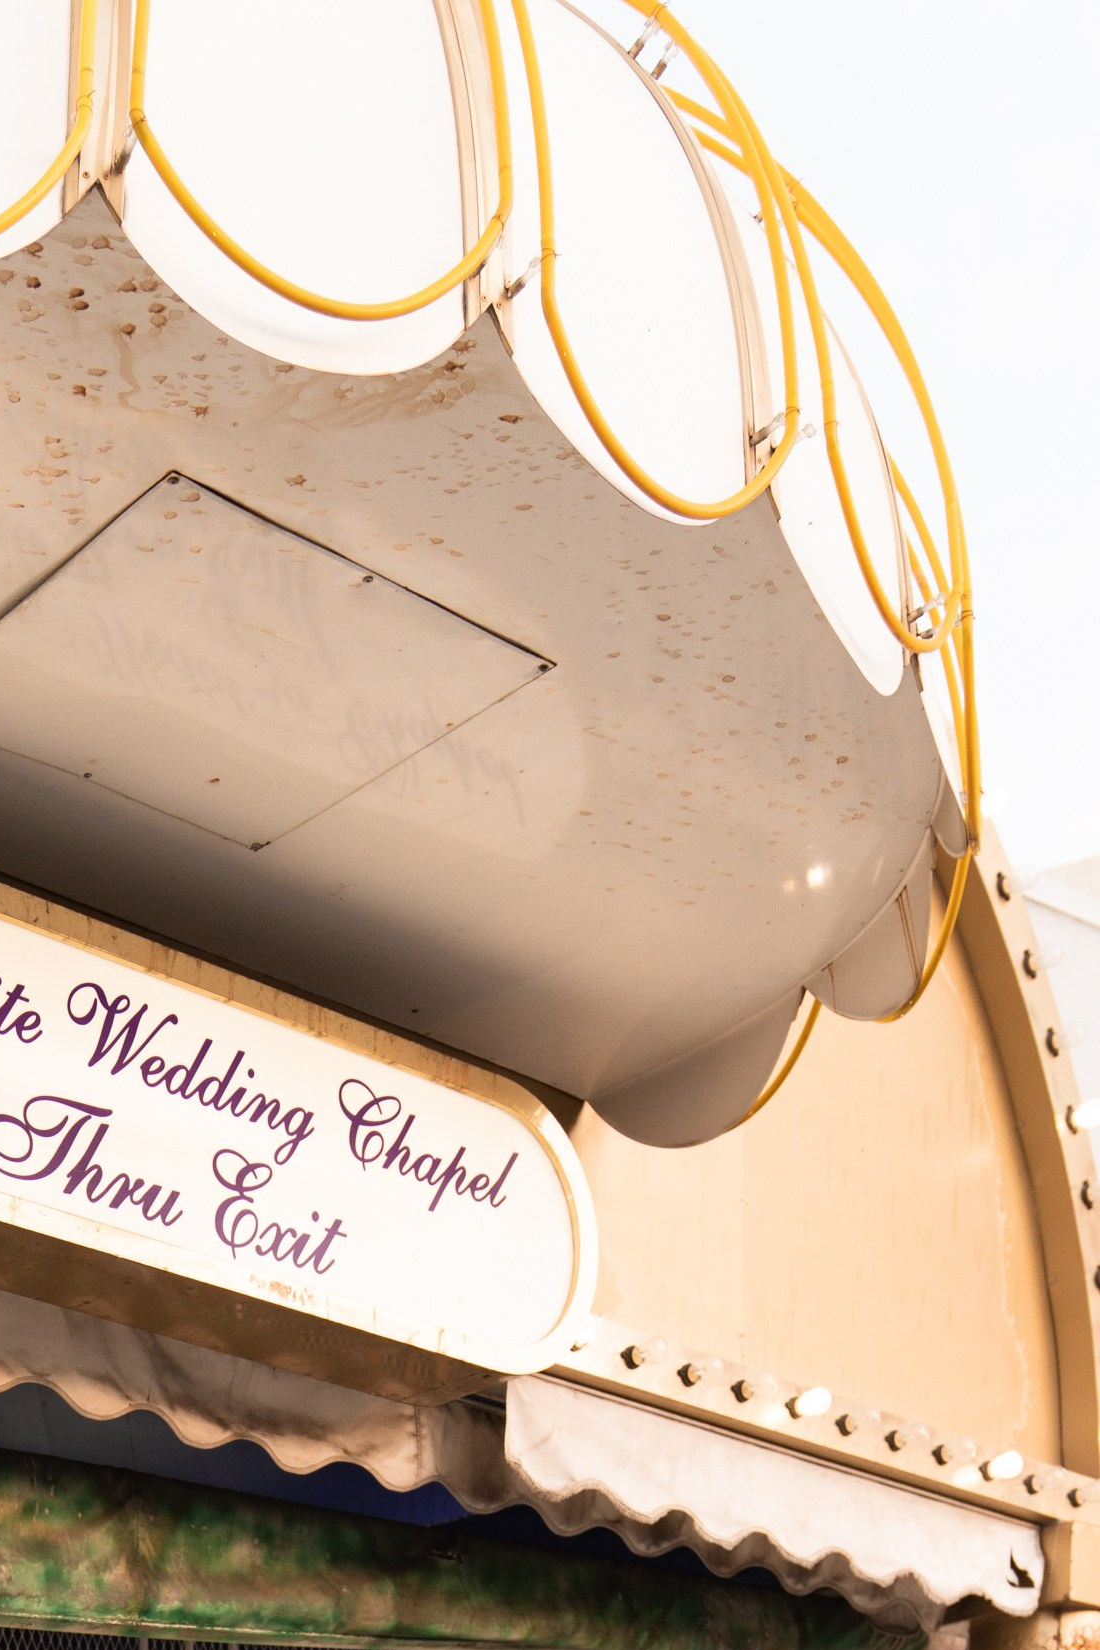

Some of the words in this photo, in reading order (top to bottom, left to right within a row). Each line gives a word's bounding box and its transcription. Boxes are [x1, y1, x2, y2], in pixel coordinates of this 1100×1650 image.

[66, 981, 315, 1166] Wedding
[337, 1077, 520, 1213] Chapel
[211, 1148, 348, 1275] Exit
